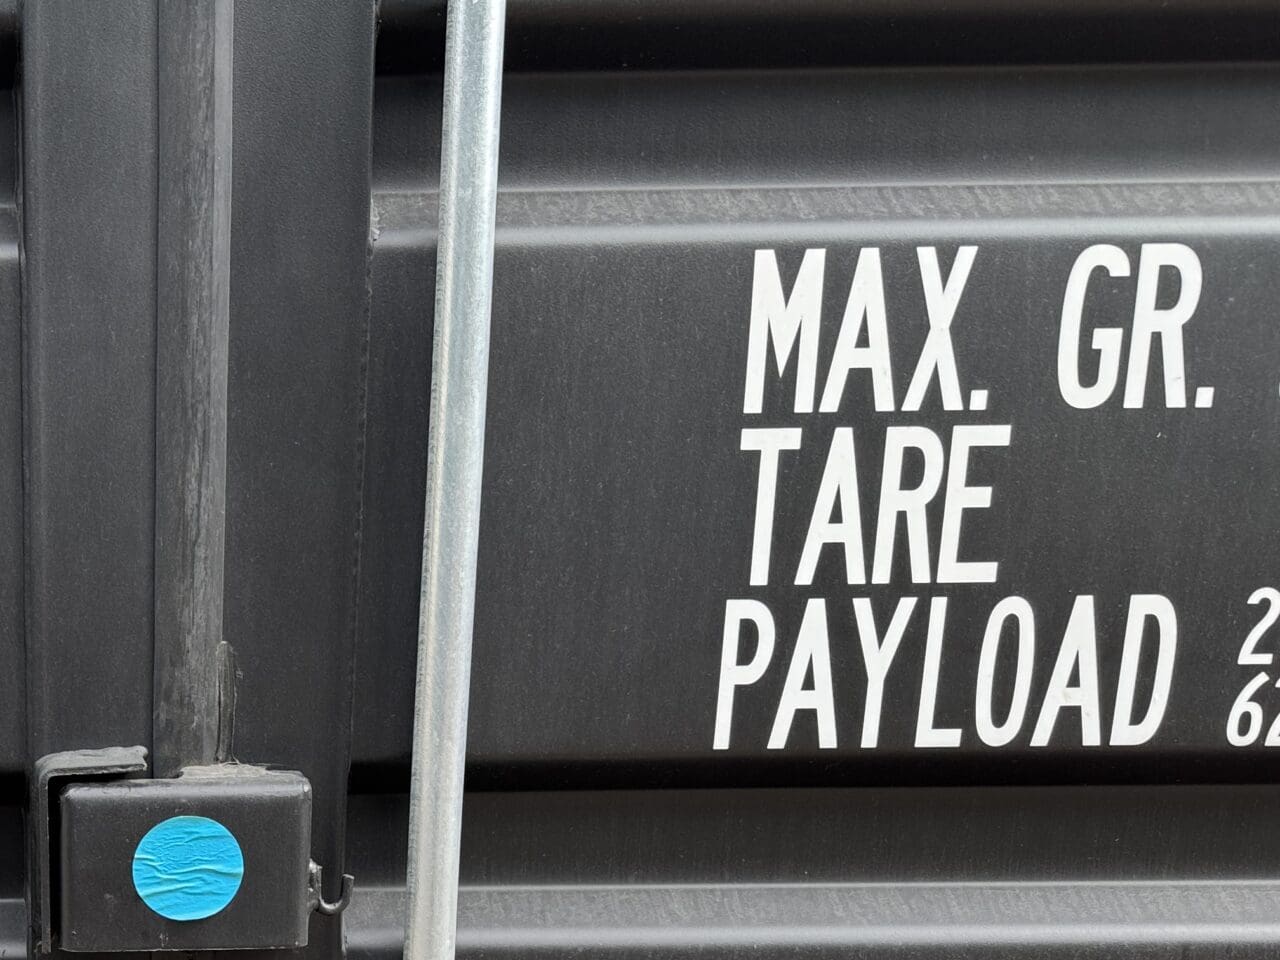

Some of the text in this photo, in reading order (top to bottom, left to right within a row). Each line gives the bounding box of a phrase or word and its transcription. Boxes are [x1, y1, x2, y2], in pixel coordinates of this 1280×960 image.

[743, 242, 1215, 413] MAX. GR.
[740, 425, 1012, 586] TARE
[713, 594, 1177, 750] PAYLOAD
